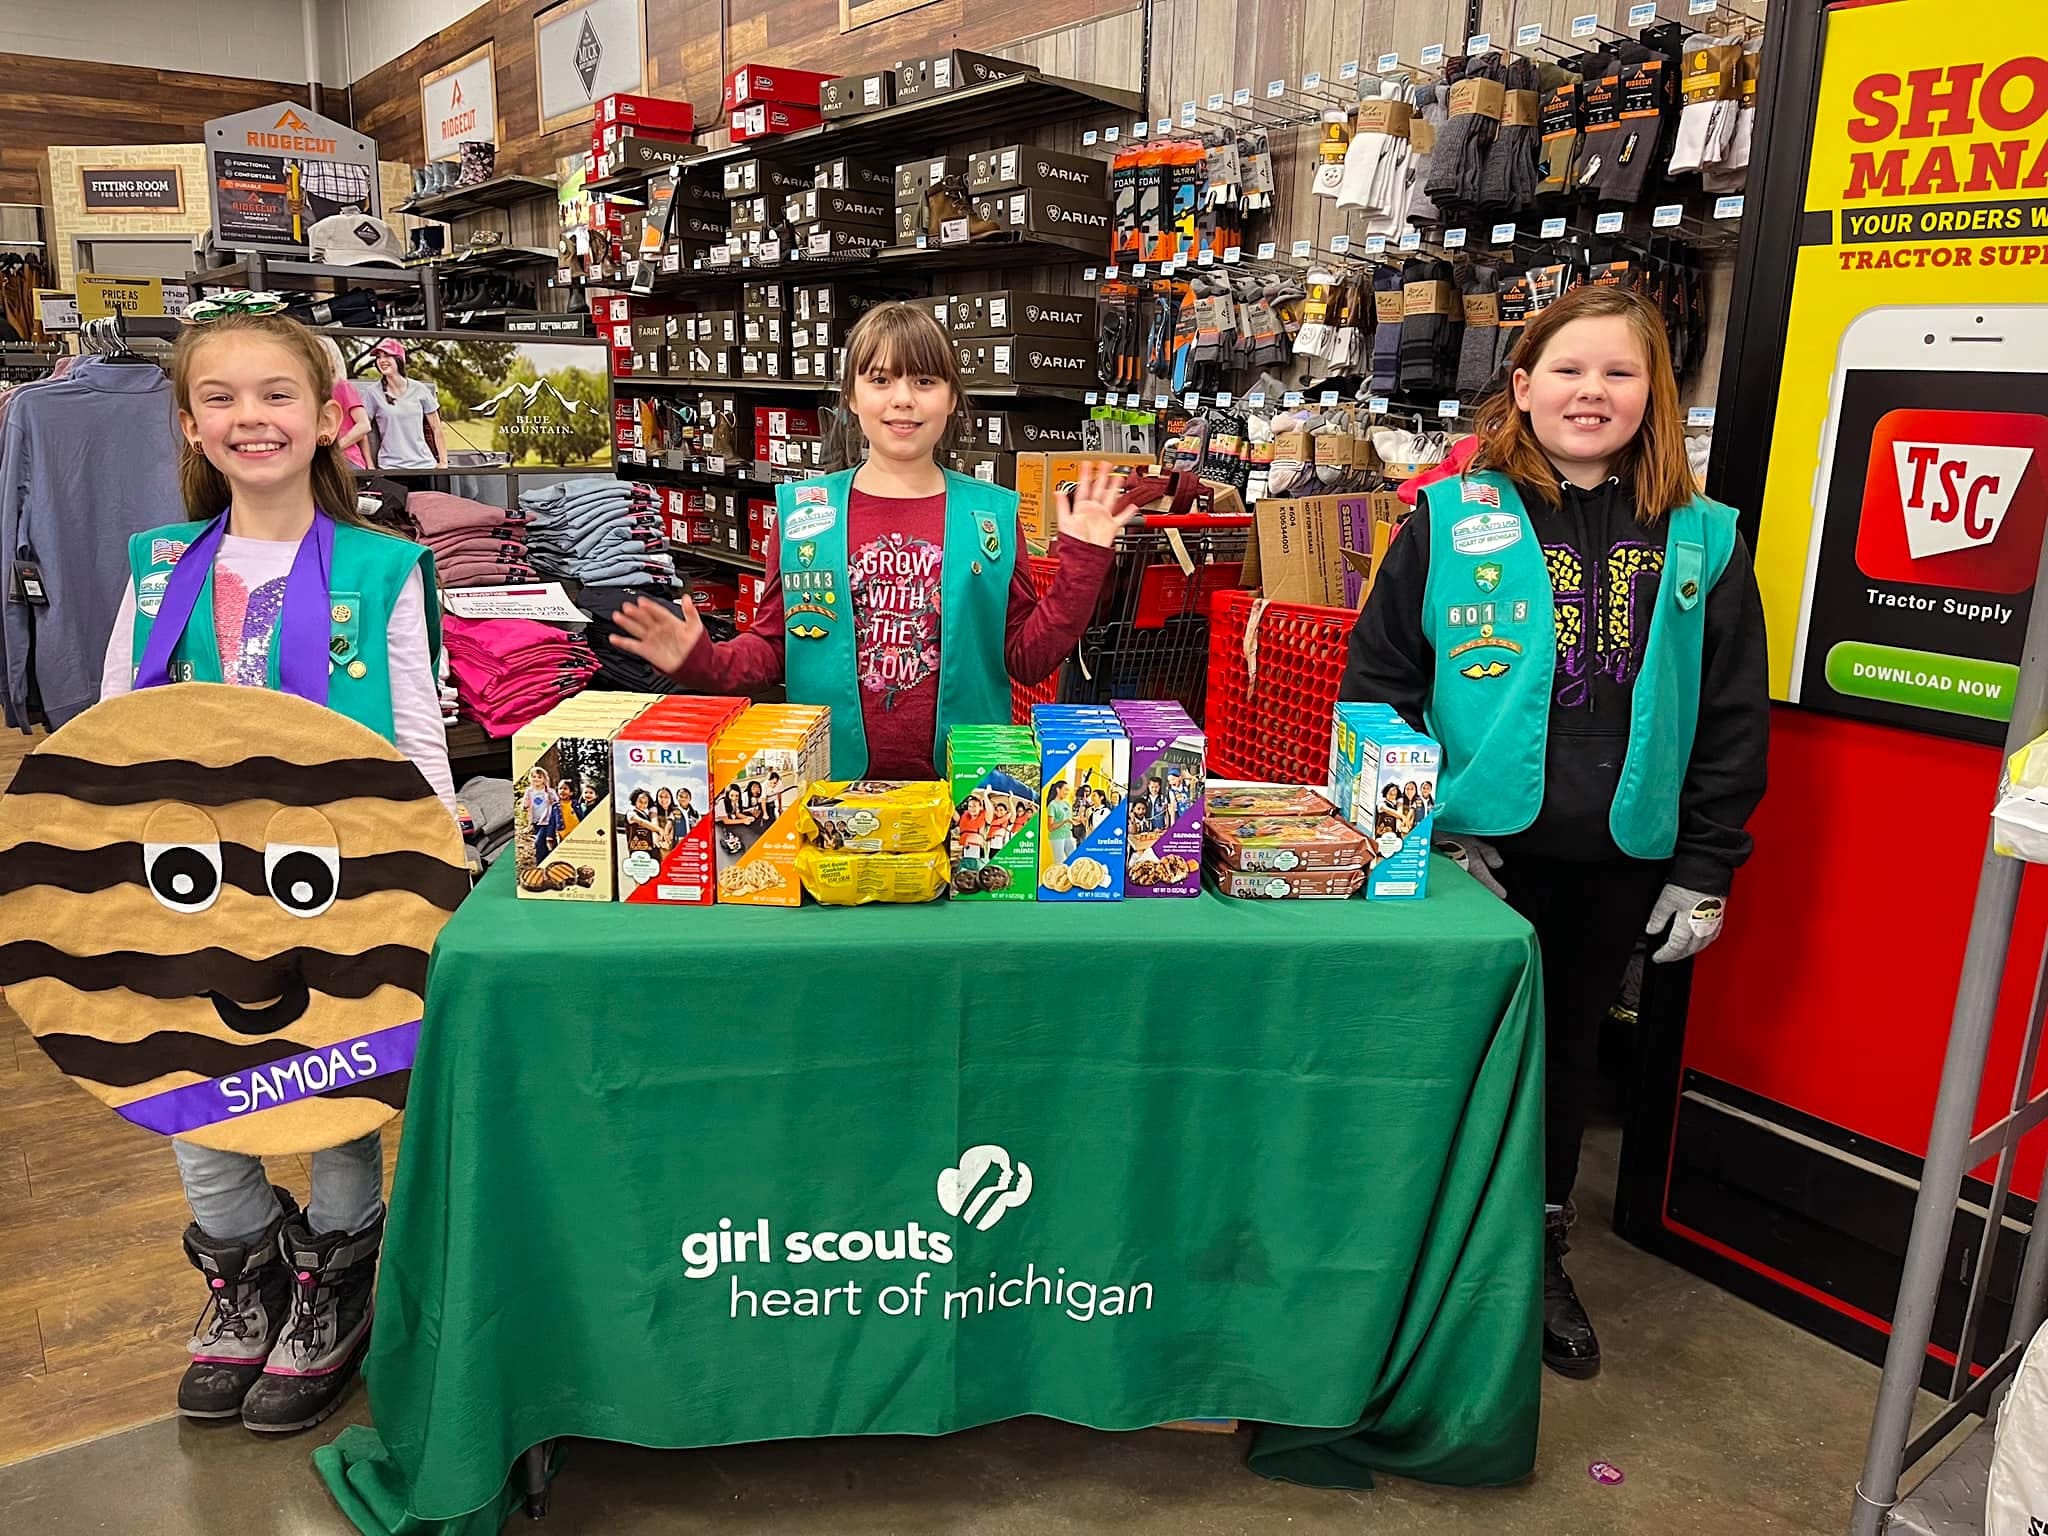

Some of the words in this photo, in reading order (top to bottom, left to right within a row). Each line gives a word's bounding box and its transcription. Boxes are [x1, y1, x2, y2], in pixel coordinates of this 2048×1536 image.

[898, 85, 920, 97] ARIAT
[1847, 56, 2048, 143] SHO
[823, 102, 843, 111] ARIAT
[441, 109, 476, 141] RIDGECUT
[247, 131, 337, 155] RIDGECUT
[233, 160, 271, 169] FUNCTIONAL
[233, 171, 277, 181] COMFORTABLE
[1049, 167, 1090, 186] ARIAT
[1173, 168, 1195, 176] ULTRA
[872, 174, 894, 185] ARI
[973, 176, 991, 186] ARIAT
[1114, 178, 1136, 189] FOAM
[1138, 176, 1161, 187] FOAM
[1173, 176, 1195, 184] MEMORY
[91, 181, 135, 192] FITTING
[136, 180, 169, 192] ROOM
[702, 188, 724, 201] ARI
[898, 188, 915, 197] ARIAT
[231, 201, 278, 213] RIDGECUT
[844, 202, 885, 216] ARIAT
[1061, 210, 1108, 228] ARIAT
[1850, 213, 1913, 236] YOUR
[1921, 207, 2022, 233] ORDERS
[899, 230, 915, 239] ARIAT
[847, 234, 887, 248] ARIAT
[1839, 247, 1972, 271] TRACTOR
[102, 289, 126, 300] PRICE
[128, 290, 139, 300] AS
[104, 300, 138, 311] MARKED
[1039, 312, 1083, 324] ARIAT
[643, 327, 660, 336] ARIAT
[953, 321, 976, 331] ARIAT
[1042, 357, 1086, 369] ARIAT
[959, 366, 976, 375] RIAT
[516, 415, 551, 424] BLUE
[1039, 429, 1084, 441] ARIAT
[1906, 446, 2000, 540] TSC
[1472, 521, 1501, 531] SCOUTS
[1502, 519, 1517, 528] USA
[1341, 504, 1356, 574] samos
[1458, 539, 1477, 548] HEART
[1486, 532, 1517, 543] MICHIGAN
[863, 549, 935, 577] GROW
[784, 571, 833, 588] 60143
[868, 585, 925, 610] WITH
[1866, 588, 1937, 613] Tractor
[1943, 598, 2013, 625] Supply
[871, 616, 912, 645] THE
[859, 651, 921, 682] FLOW
[1853, 662, 1952, 691] DOWNLOAD
[1957, 677, 2002, 700] NOW
[219, 1040, 378, 1113] SAMOAS
[681, 1216, 771, 1280] girl
[784, 1221, 954, 1266] scouts
[729, 1274, 863, 1320] heart
[877, 1272, 932, 1318] of
[942, 1262, 1155, 1323] michigan
